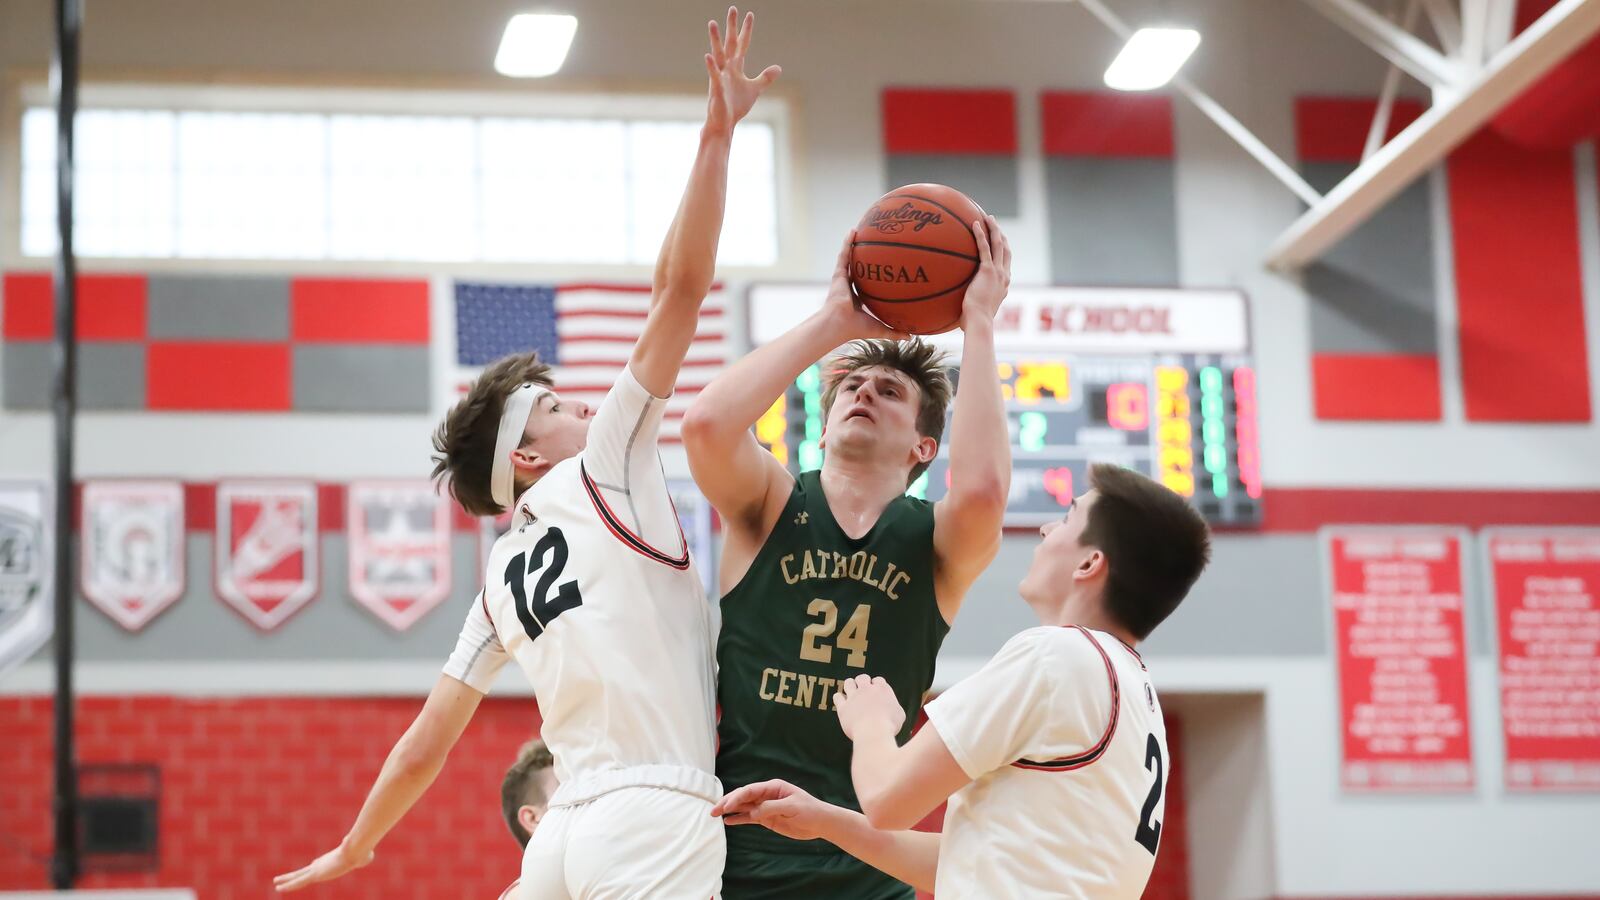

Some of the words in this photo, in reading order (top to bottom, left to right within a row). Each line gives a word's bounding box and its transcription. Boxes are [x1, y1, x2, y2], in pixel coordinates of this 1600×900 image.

[854, 260, 929, 284] OHSAA
[504, 526, 583, 642] 12
[780, 549, 911, 600] CATHOLIC
[799, 597, 871, 669] 24
[758, 667, 846, 712] CENT
[1134, 732, 1163, 857] 2
